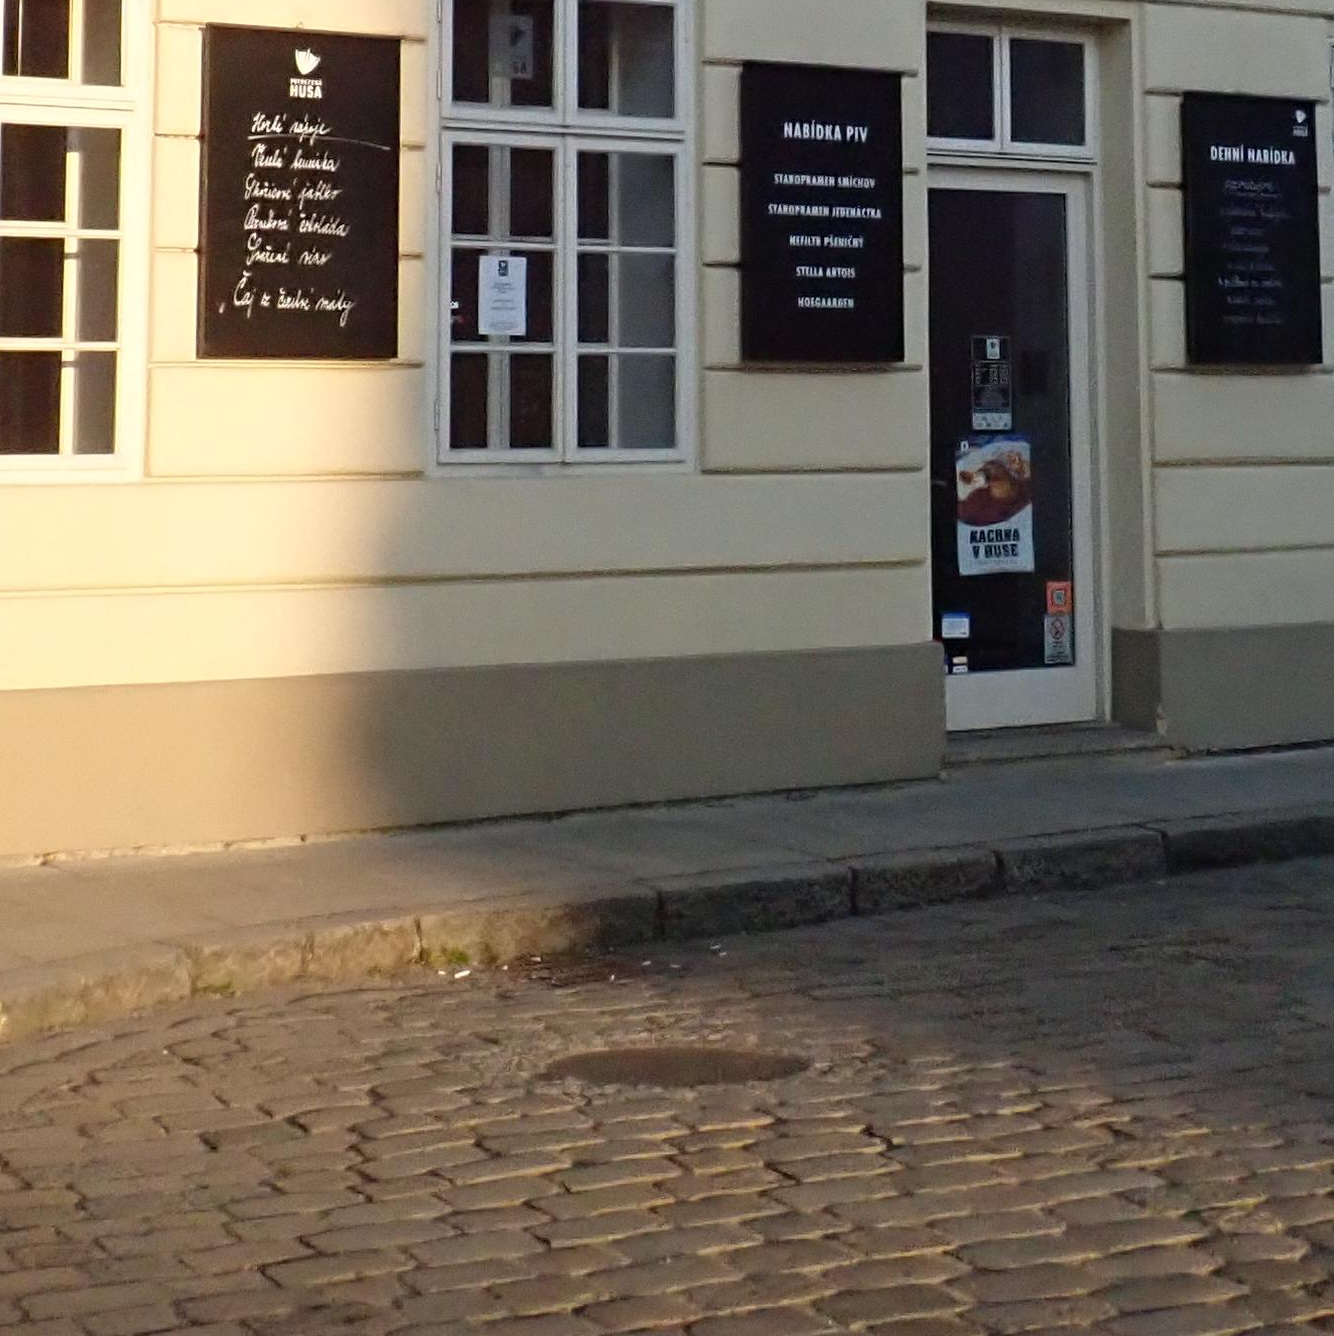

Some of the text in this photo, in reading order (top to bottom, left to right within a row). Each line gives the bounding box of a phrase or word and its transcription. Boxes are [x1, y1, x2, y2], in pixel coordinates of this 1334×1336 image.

[289, 84, 323, 99] HUSA
[783, 120, 868, 143] NABÍDKA PIV
[1210, 144, 1296, 165] DENNÍ NABÍDKA
[795, 265, 824, 278] STELLA
[984, 544, 1019, 559] HUSE
